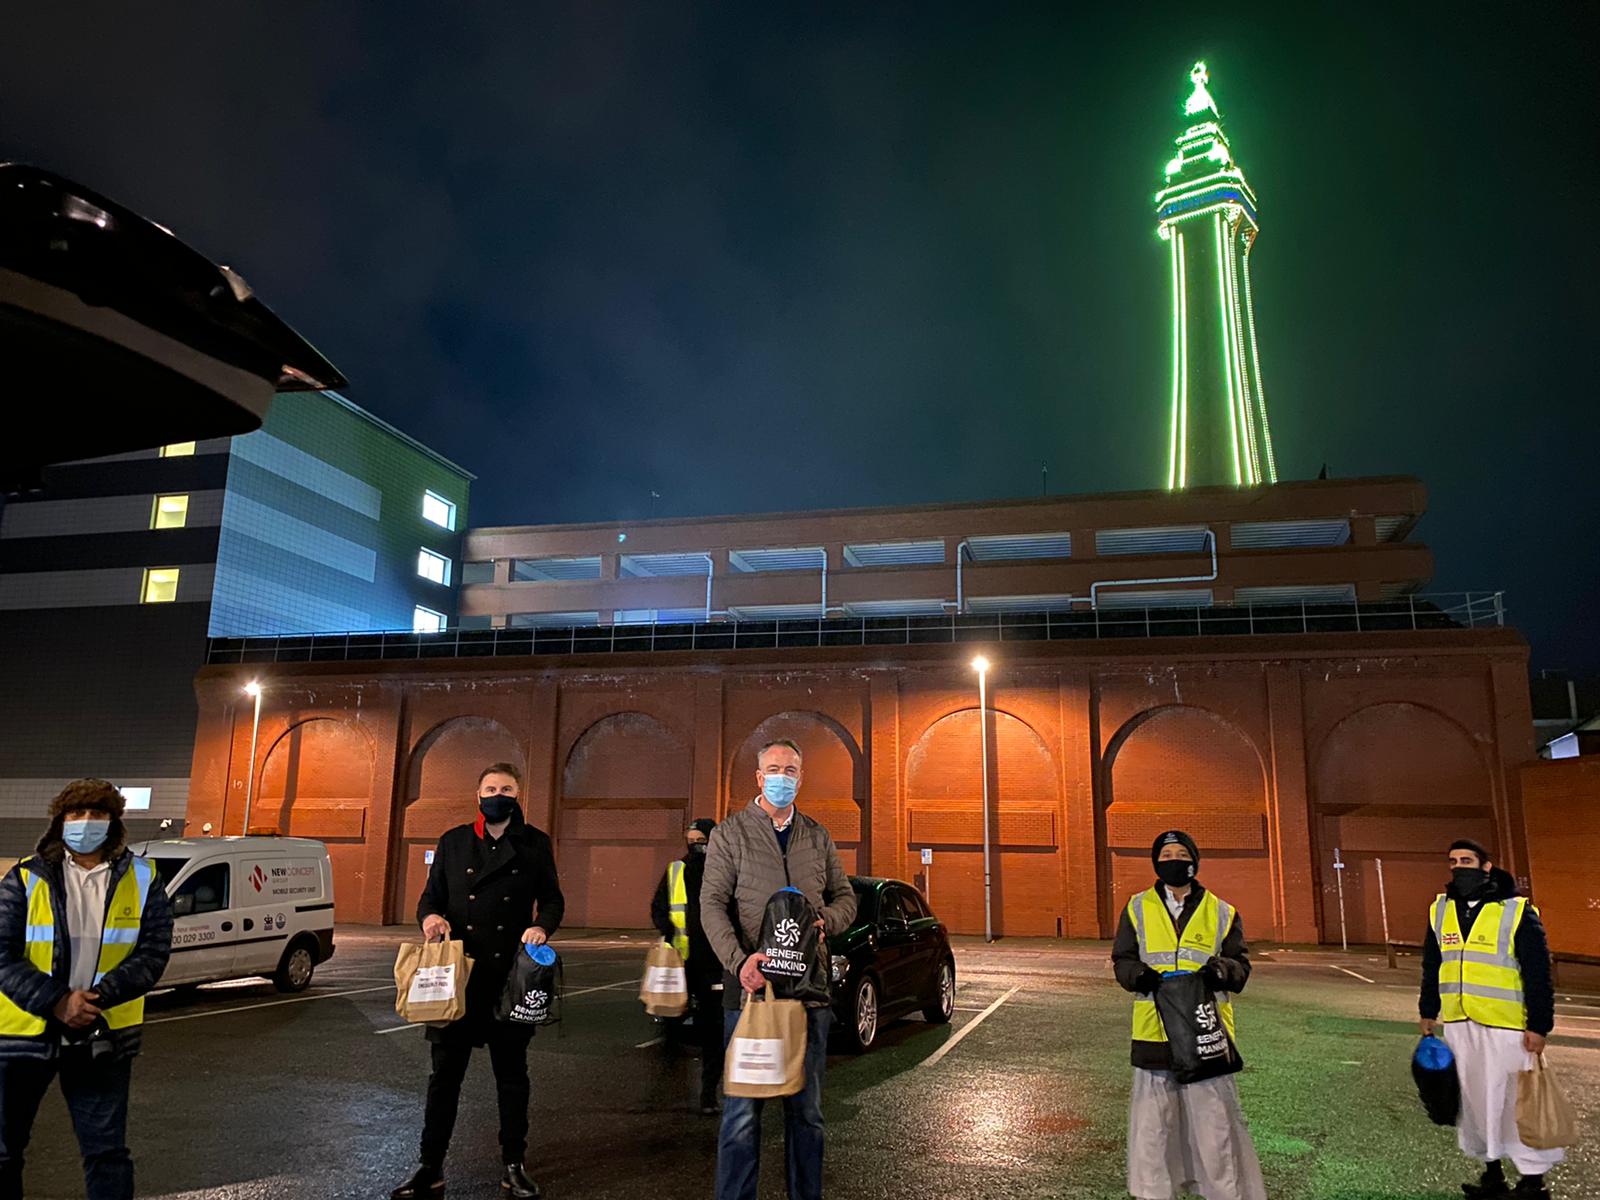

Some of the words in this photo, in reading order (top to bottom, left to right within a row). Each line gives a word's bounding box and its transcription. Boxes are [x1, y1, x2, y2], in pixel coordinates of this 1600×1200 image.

[271, 867, 286, 877] NEW
[183, 933, 197, 943] 029
[198, 931, 215, 942] 3300
[766, 948, 804, 961] BENEFIT
[510, 1010, 548, 1022] MANKIND
[515, 1004, 548, 1016] BENEFIT
